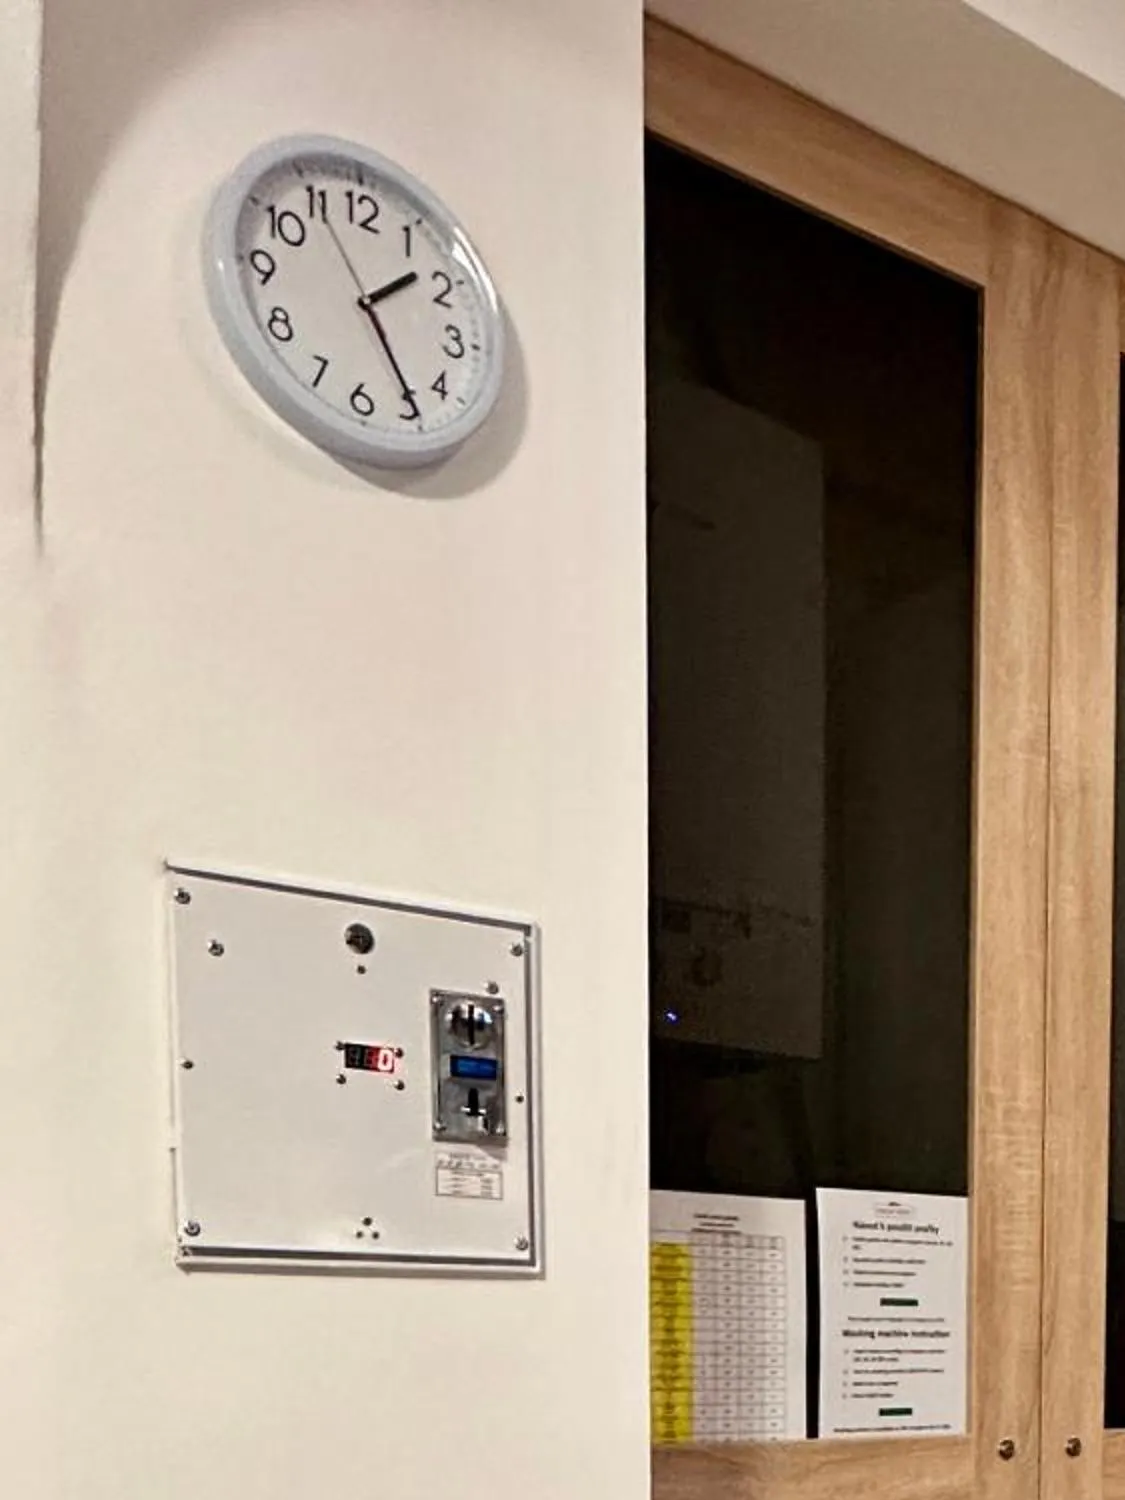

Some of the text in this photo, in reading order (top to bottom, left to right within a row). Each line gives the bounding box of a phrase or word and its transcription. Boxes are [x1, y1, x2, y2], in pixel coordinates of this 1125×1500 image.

[306, 185, 328, 224] 11
[345, 190, 380, 234] 12
[266, 204, 307, 248] 10
[402, 225, 412, 258] 1
[249, 249, 276, 286] 9
[431, 271, 453, 309] 2
[268, 306, 294, 342] 8
[442, 324, 466, 359] 3
[313, 355, 329, 388] 7
[431, 370, 449, 402] 4
[350, 383, 375, 417] 6
